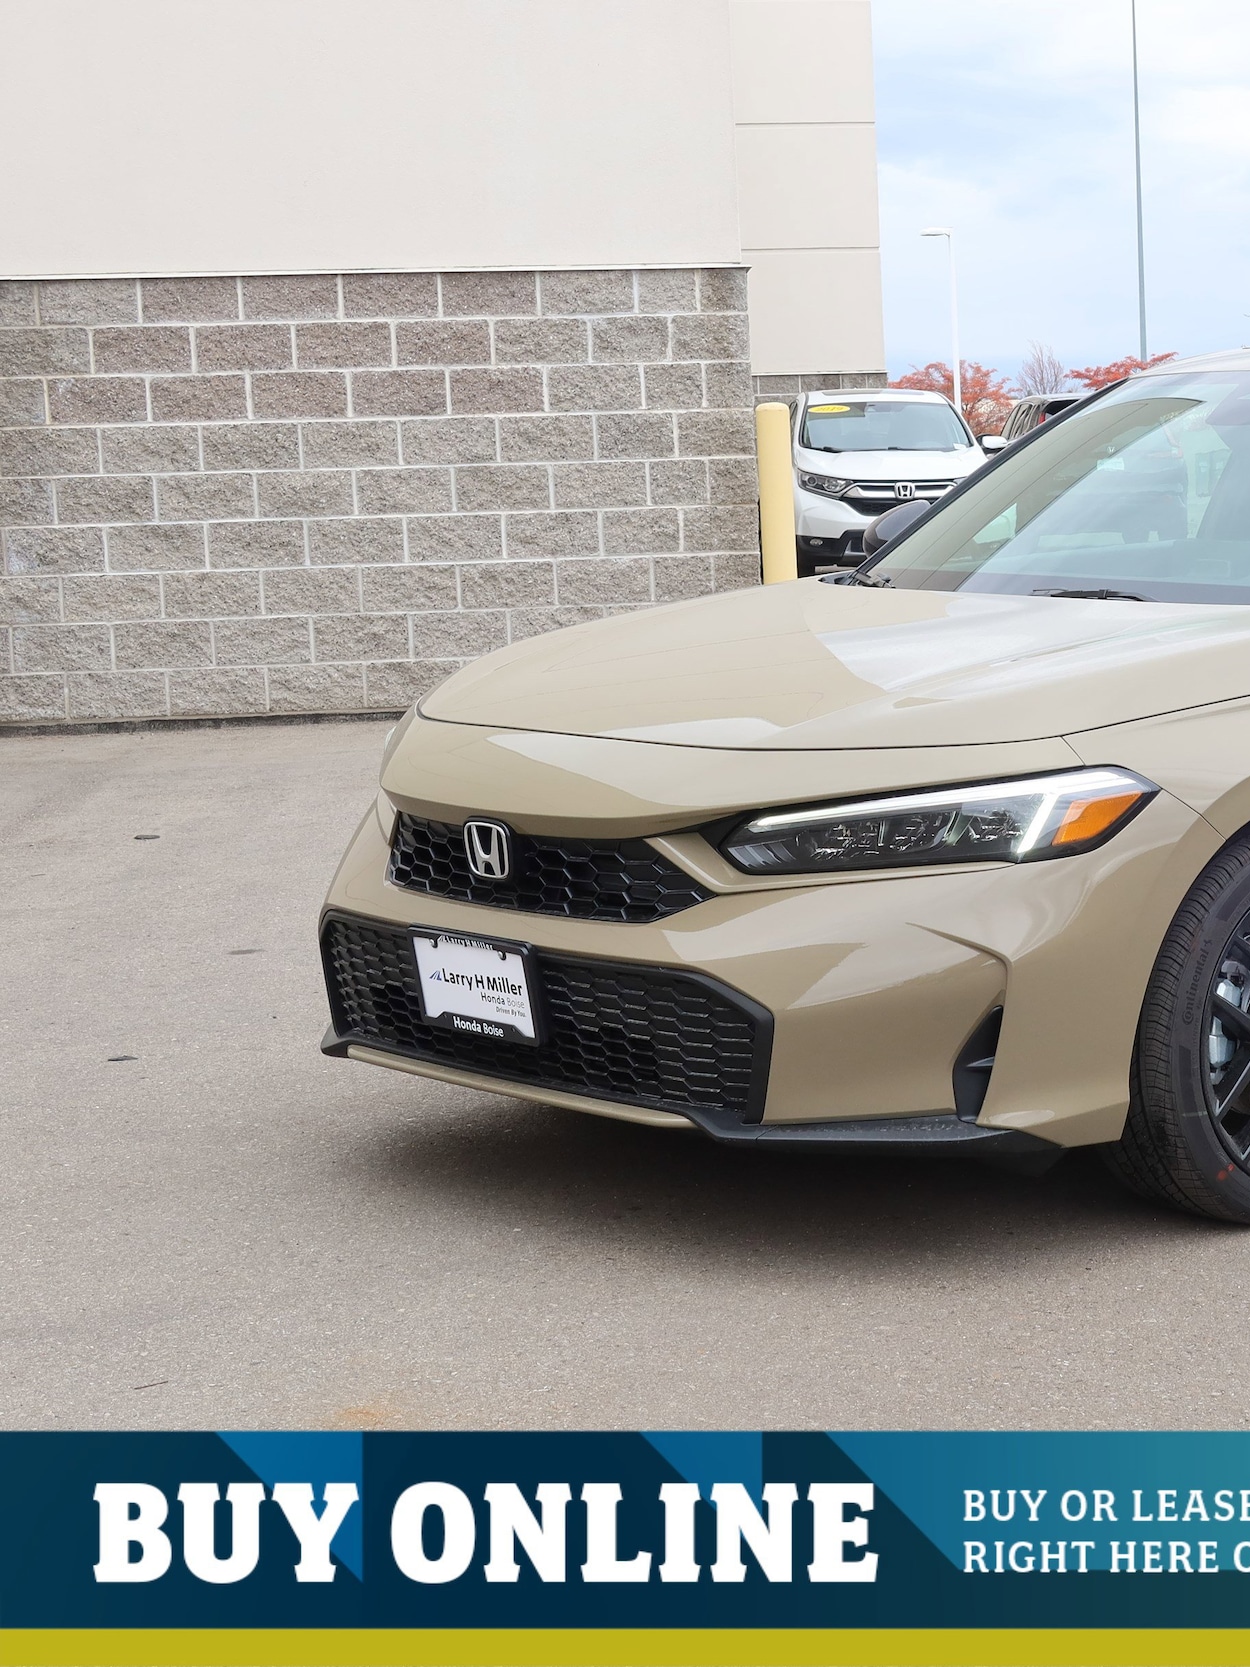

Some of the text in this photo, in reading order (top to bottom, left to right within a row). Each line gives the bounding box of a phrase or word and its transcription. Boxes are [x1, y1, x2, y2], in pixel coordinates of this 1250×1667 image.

[441, 968, 523, 996] Larry H Miller
[1182, 949, 1210, 1026] Continental
[481, 992, 525, 1009] Honda Boise
[495, 1006, 510, 1015] Driven
[511, 1009, 517, 1017] By
[453, 1016, 505, 1038] Honda Boise
